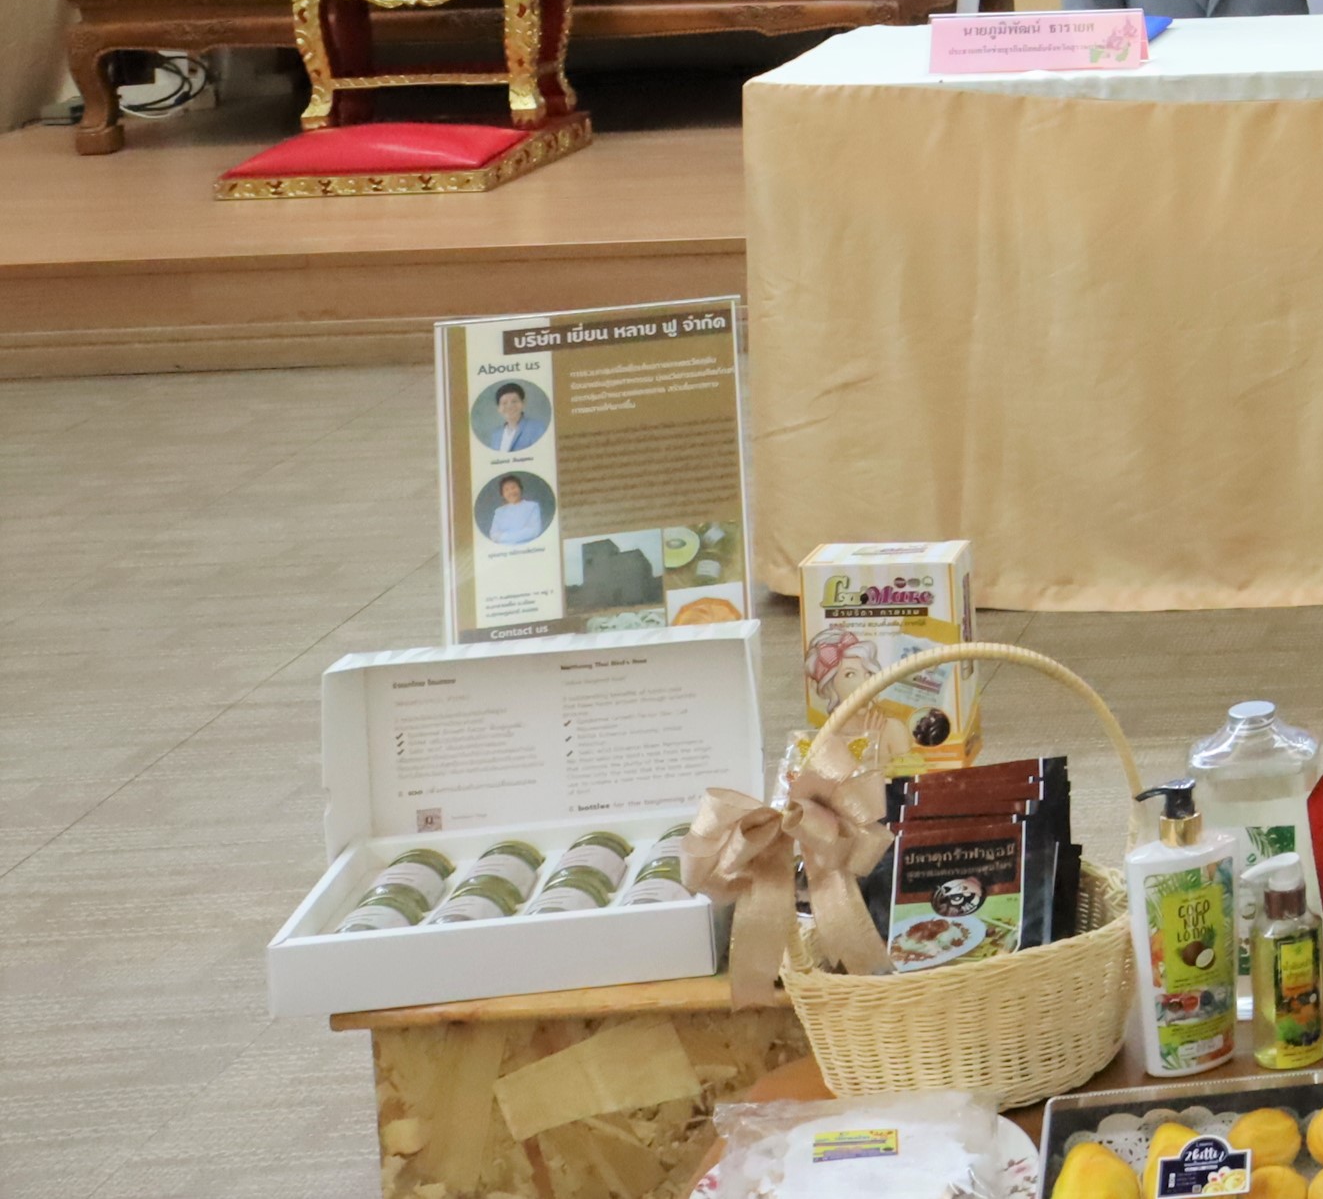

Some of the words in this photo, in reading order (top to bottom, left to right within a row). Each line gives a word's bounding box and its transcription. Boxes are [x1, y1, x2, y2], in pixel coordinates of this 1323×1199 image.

[963, 19, 1041, 40] นายภูมิพัฒน์
[513, 328, 560, 350] บริษัท
[566, 322, 609, 345] เยี่ยน
[614, 321, 657, 341] หลาย
[661, 320, 679, 339] ฟู
[683, 314, 726, 333] จำกัด
[477, 361, 522, 377] About
[525, 362, 541, 371] us
[490, 624, 533, 641] Contact
[535, 624, 549, 635] us
[1178, 899, 1211, 919] COCO
[1183, 914, 1207, 931] NUT
